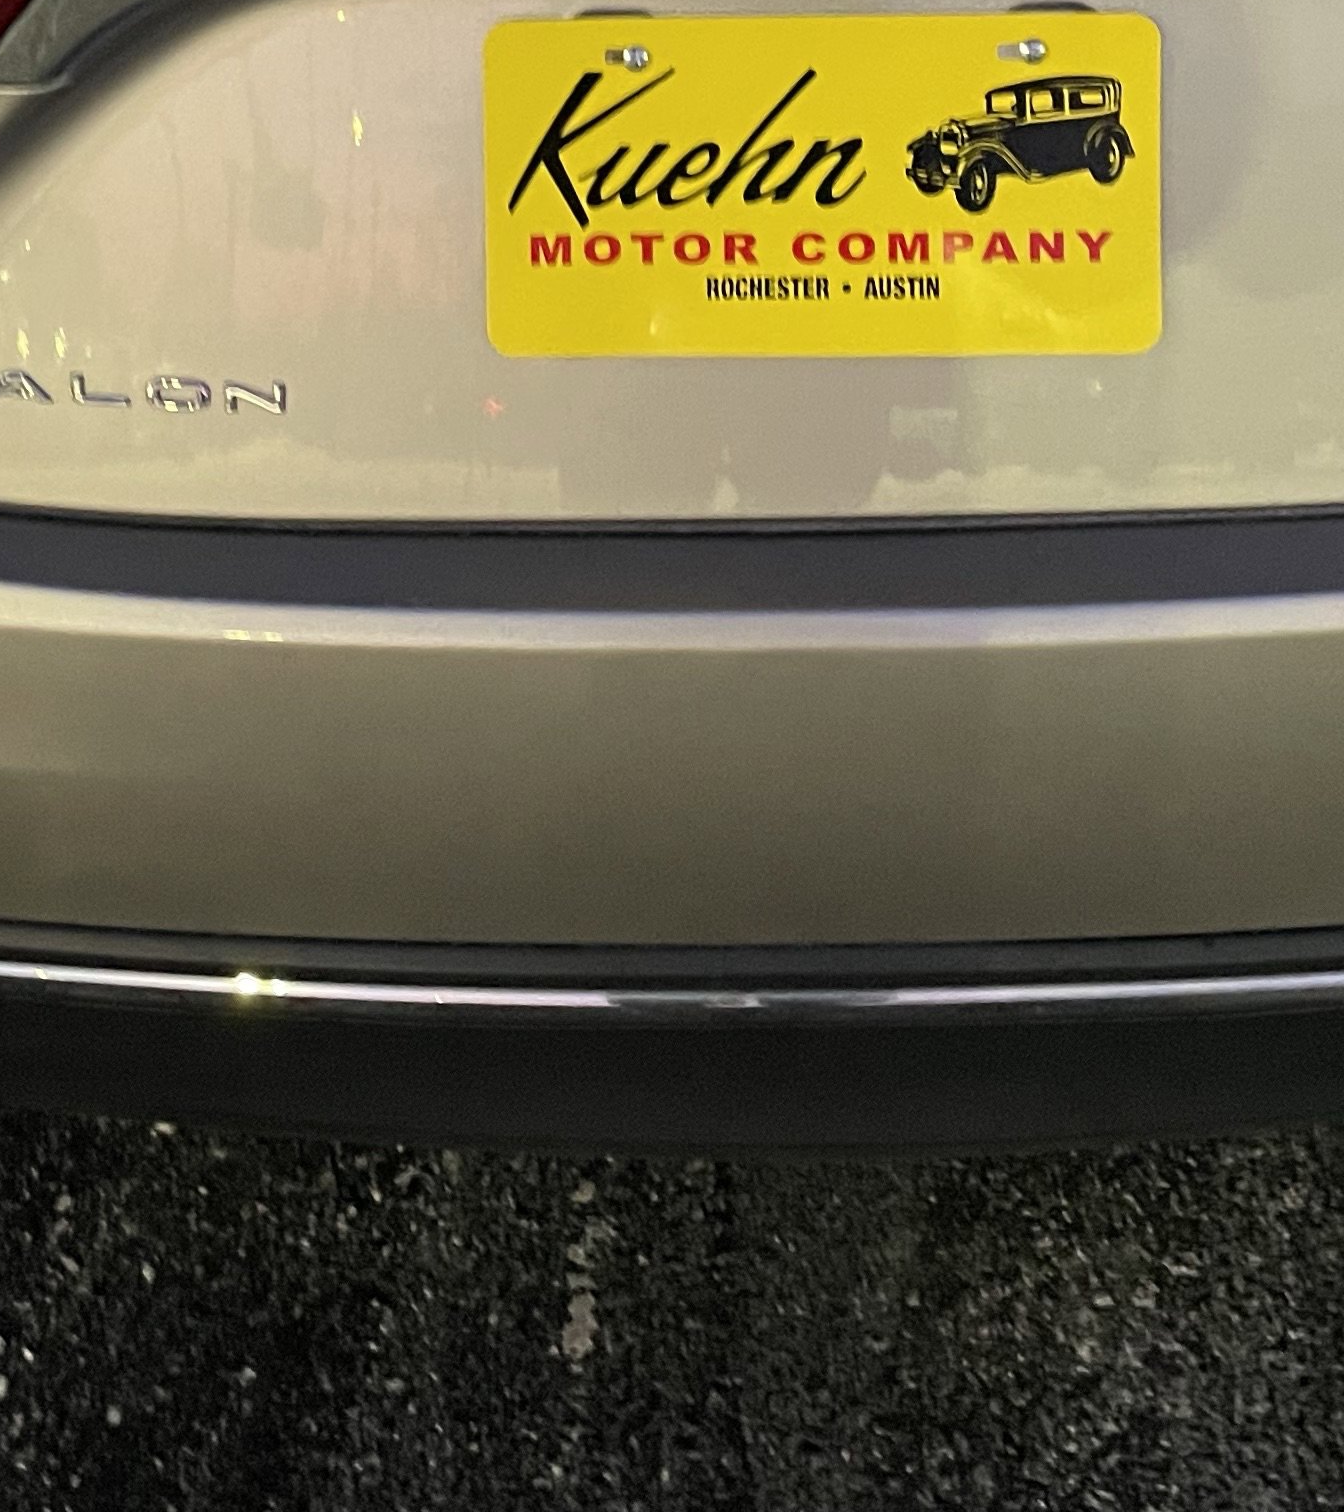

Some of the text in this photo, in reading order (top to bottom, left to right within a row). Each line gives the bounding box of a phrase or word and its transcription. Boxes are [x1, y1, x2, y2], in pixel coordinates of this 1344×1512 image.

[506, 66, 868, 230] Kuehn
[529, 230, 1113, 267] MOTOR COMPANY
[706, 274, 940, 301] ROCHESTER AUSTIN
